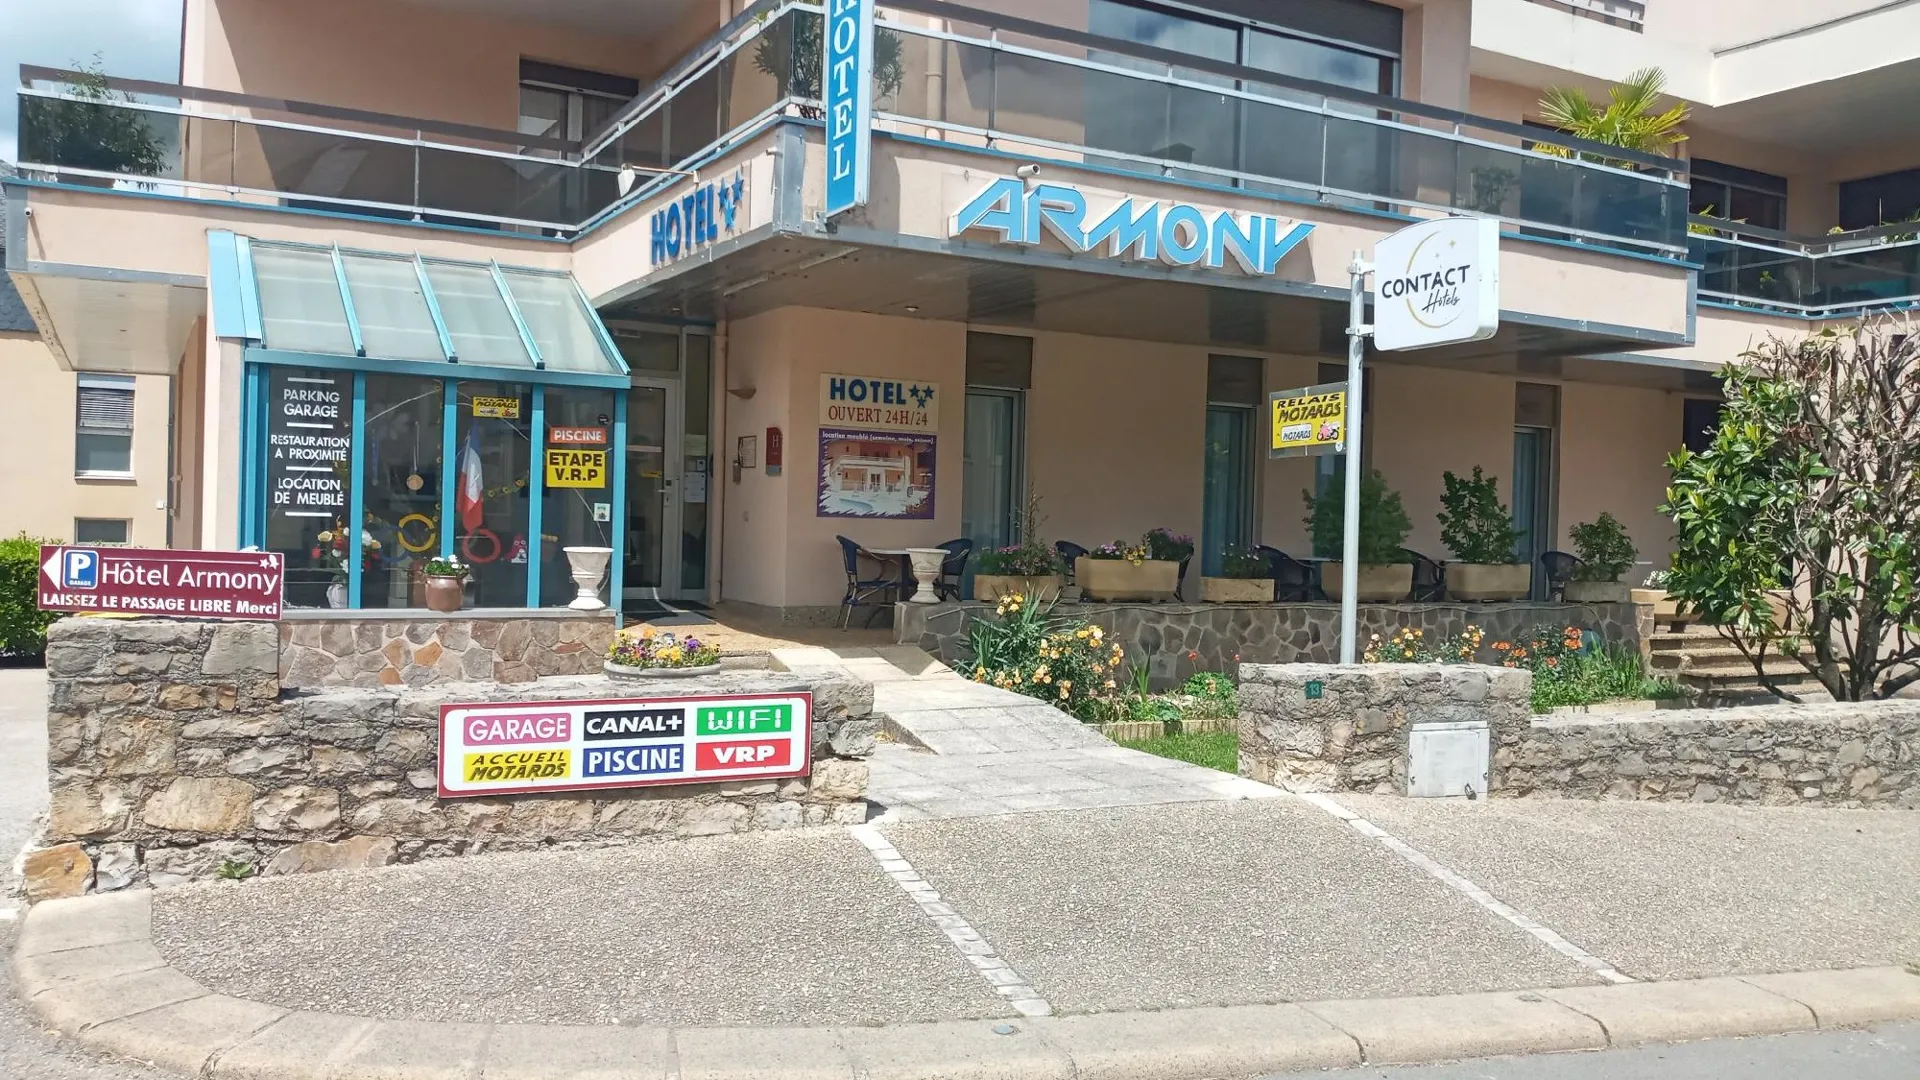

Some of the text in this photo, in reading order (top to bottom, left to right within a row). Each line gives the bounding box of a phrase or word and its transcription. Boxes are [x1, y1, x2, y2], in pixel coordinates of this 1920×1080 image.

[651, 183, 718, 265] HOTEL
[948, 177, 1317, 275] ARMONY
[1382, 265, 1471, 299] CONTACT
[1422, 287, 1460, 314] Hotels
[283, 388, 340, 403] PARKING
[829, 377, 907, 405] HOTEL
[1277, 393, 1340, 409] RELAIS
[283, 403, 339, 418] GARAGE
[828, 405, 928, 426] OUVERT 24H/24
[1278, 401, 1341, 424] MOTARDS
[270, 434, 350, 448] RESTAURATION
[553, 430, 602, 442] PISCINE
[274, 447, 347, 461] A PROXIMITÉ
[549, 452, 603, 467] ETAPE
[278, 477, 341, 491] LOCATION
[555, 468, 599, 481] V.R.P
[274, 491, 344, 506] DE MEUBLÉ
[70, 553, 91, 579] P
[102, 562, 278, 596] Hôtel Armony
[43, 592, 278, 615] LAISSEZ LE PASSAGE LIBRE Merci
[1309, 683, 1320, 696] 13
[468, 716, 567, 741] GARAGE
[586, 714, 683, 735] CANAL+
[707, 708, 782, 731] WIFI
[471, 751, 565, 767] ACCUEIL
[588, 747, 682, 774] PISCINE
[712, 744, 776, 765] VRP
[468, 762, 567, 782] MOTARDS
